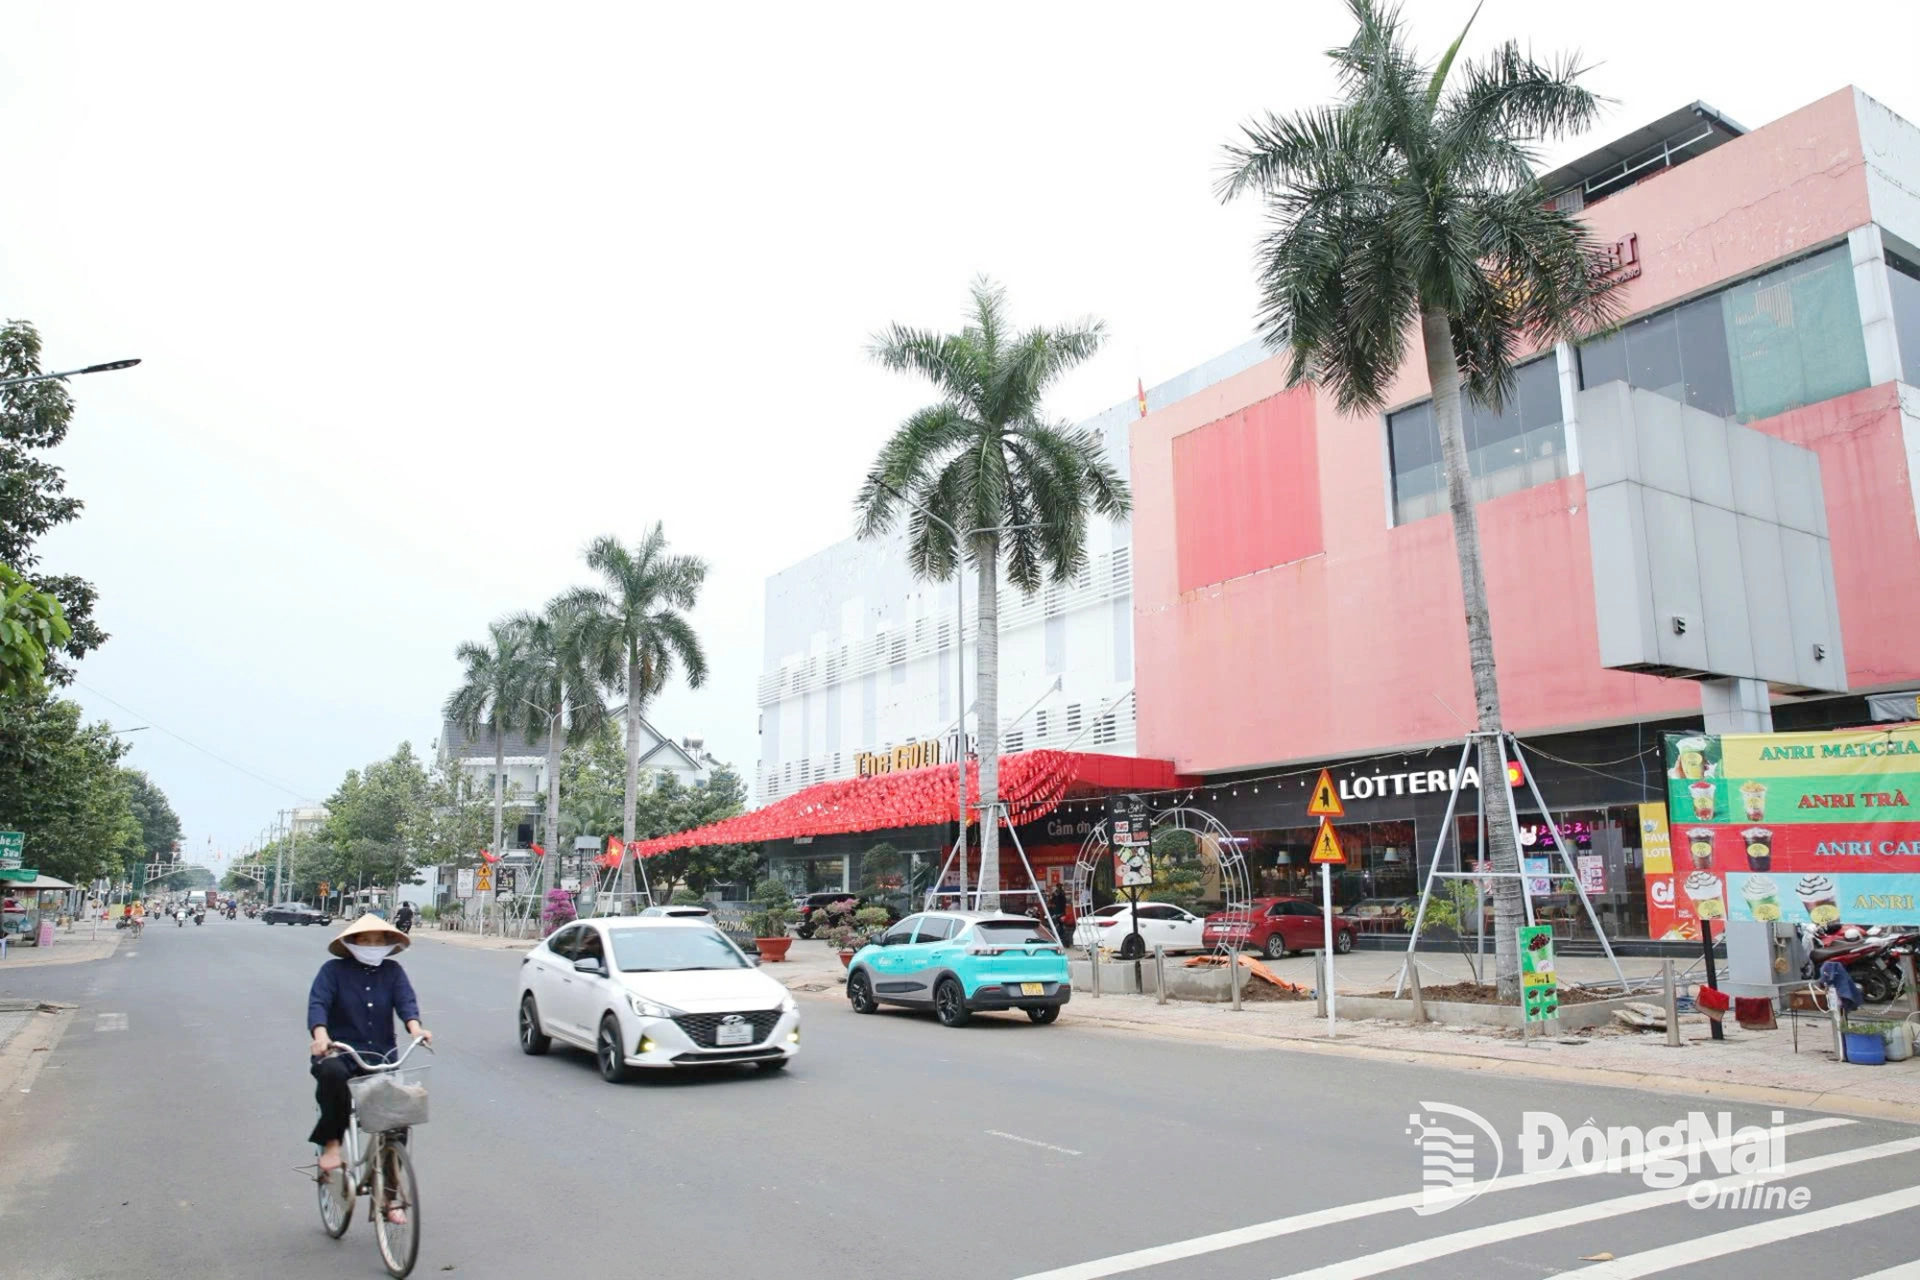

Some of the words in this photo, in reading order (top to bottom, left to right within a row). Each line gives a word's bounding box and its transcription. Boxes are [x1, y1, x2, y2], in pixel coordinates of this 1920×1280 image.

[854, 752, 890, 775] The
[890, 739, 940, 771] GOLD
[943, 733, 979, 764] MR
[1759, 745, 1815, 760] ANRI
[1820, 740, 1920, 759] MATCHA
[1340, 766, 1480, 800] LOTTERIA
[1798, 793, 1856, 809] ANRI
[1861, 789, 1909, 807] TRÀ
[1047, 819, 1073, 836] Cảm
[1814, 840, 1872, 856] ANRI
[1853, 894, 1914, 909] ANRI
